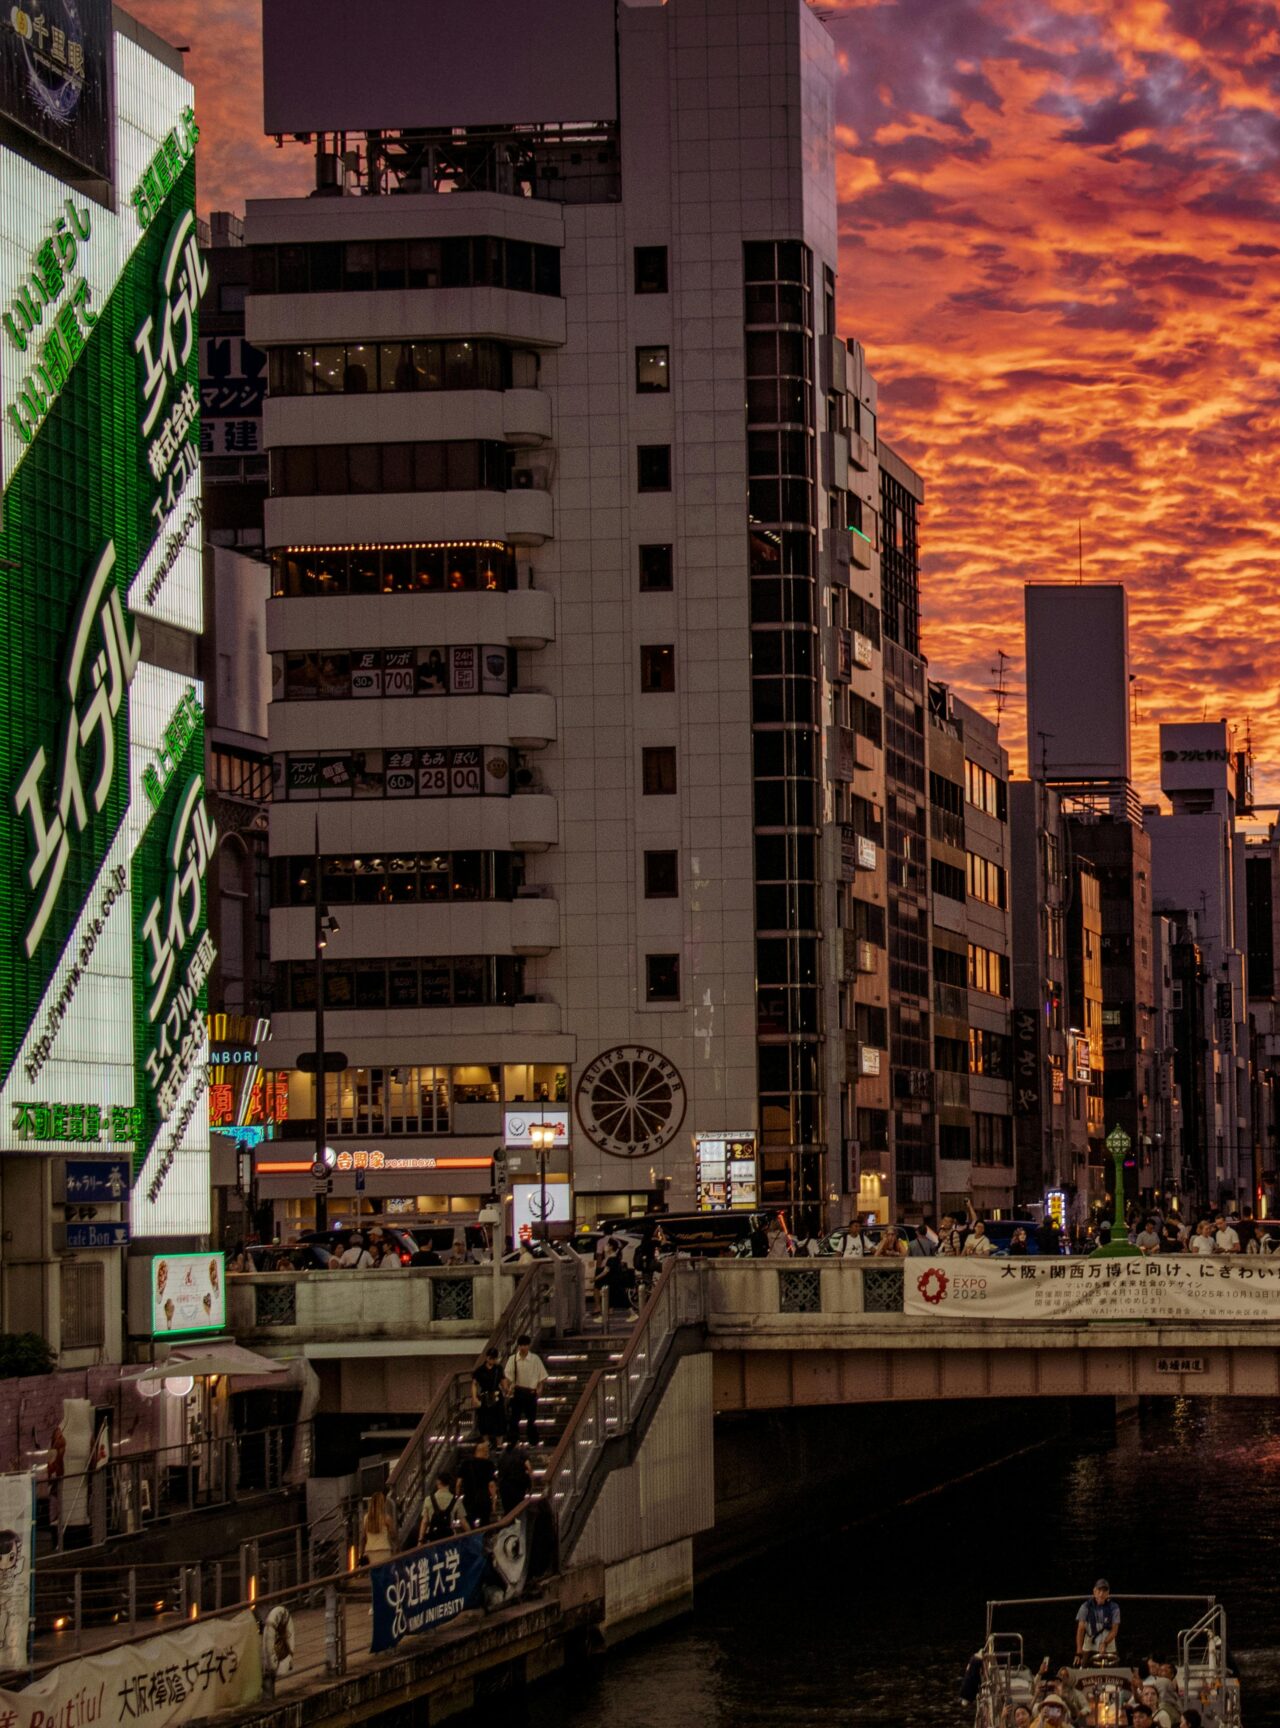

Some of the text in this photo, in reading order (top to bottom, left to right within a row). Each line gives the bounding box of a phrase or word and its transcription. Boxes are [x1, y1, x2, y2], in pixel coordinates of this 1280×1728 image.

[33, 14, 85, 80] 千里眼
[3, 198, 91, 352] いい暮らし
[133, 234, 210, 401] エイブル
[7, 275, 99, 444] いい部屋で
[148, 381, 201, 482] 株式会社
[151, 440, 200, 534] エイブル
[14, 585, 142, 891] エイブル
[142, 798, 217, 986] エイブル
[146, 929, 218, 1089] エイブル保証
[158, 1007, 209, 1122] 株式会社
[579, 1049, 682, 1095] FRUITS TOWER
[337, 1150, 385, 1170] 吉野家
[587, 1124, 675, 1154] フルーツタワー
[88, 1226, 110, 1245] Bon
[953, 1278, 987, 1288] EXPO
[953, 1289, 987, 1300] 2025
[406, 1547, 461, 1608] 近畿大学
